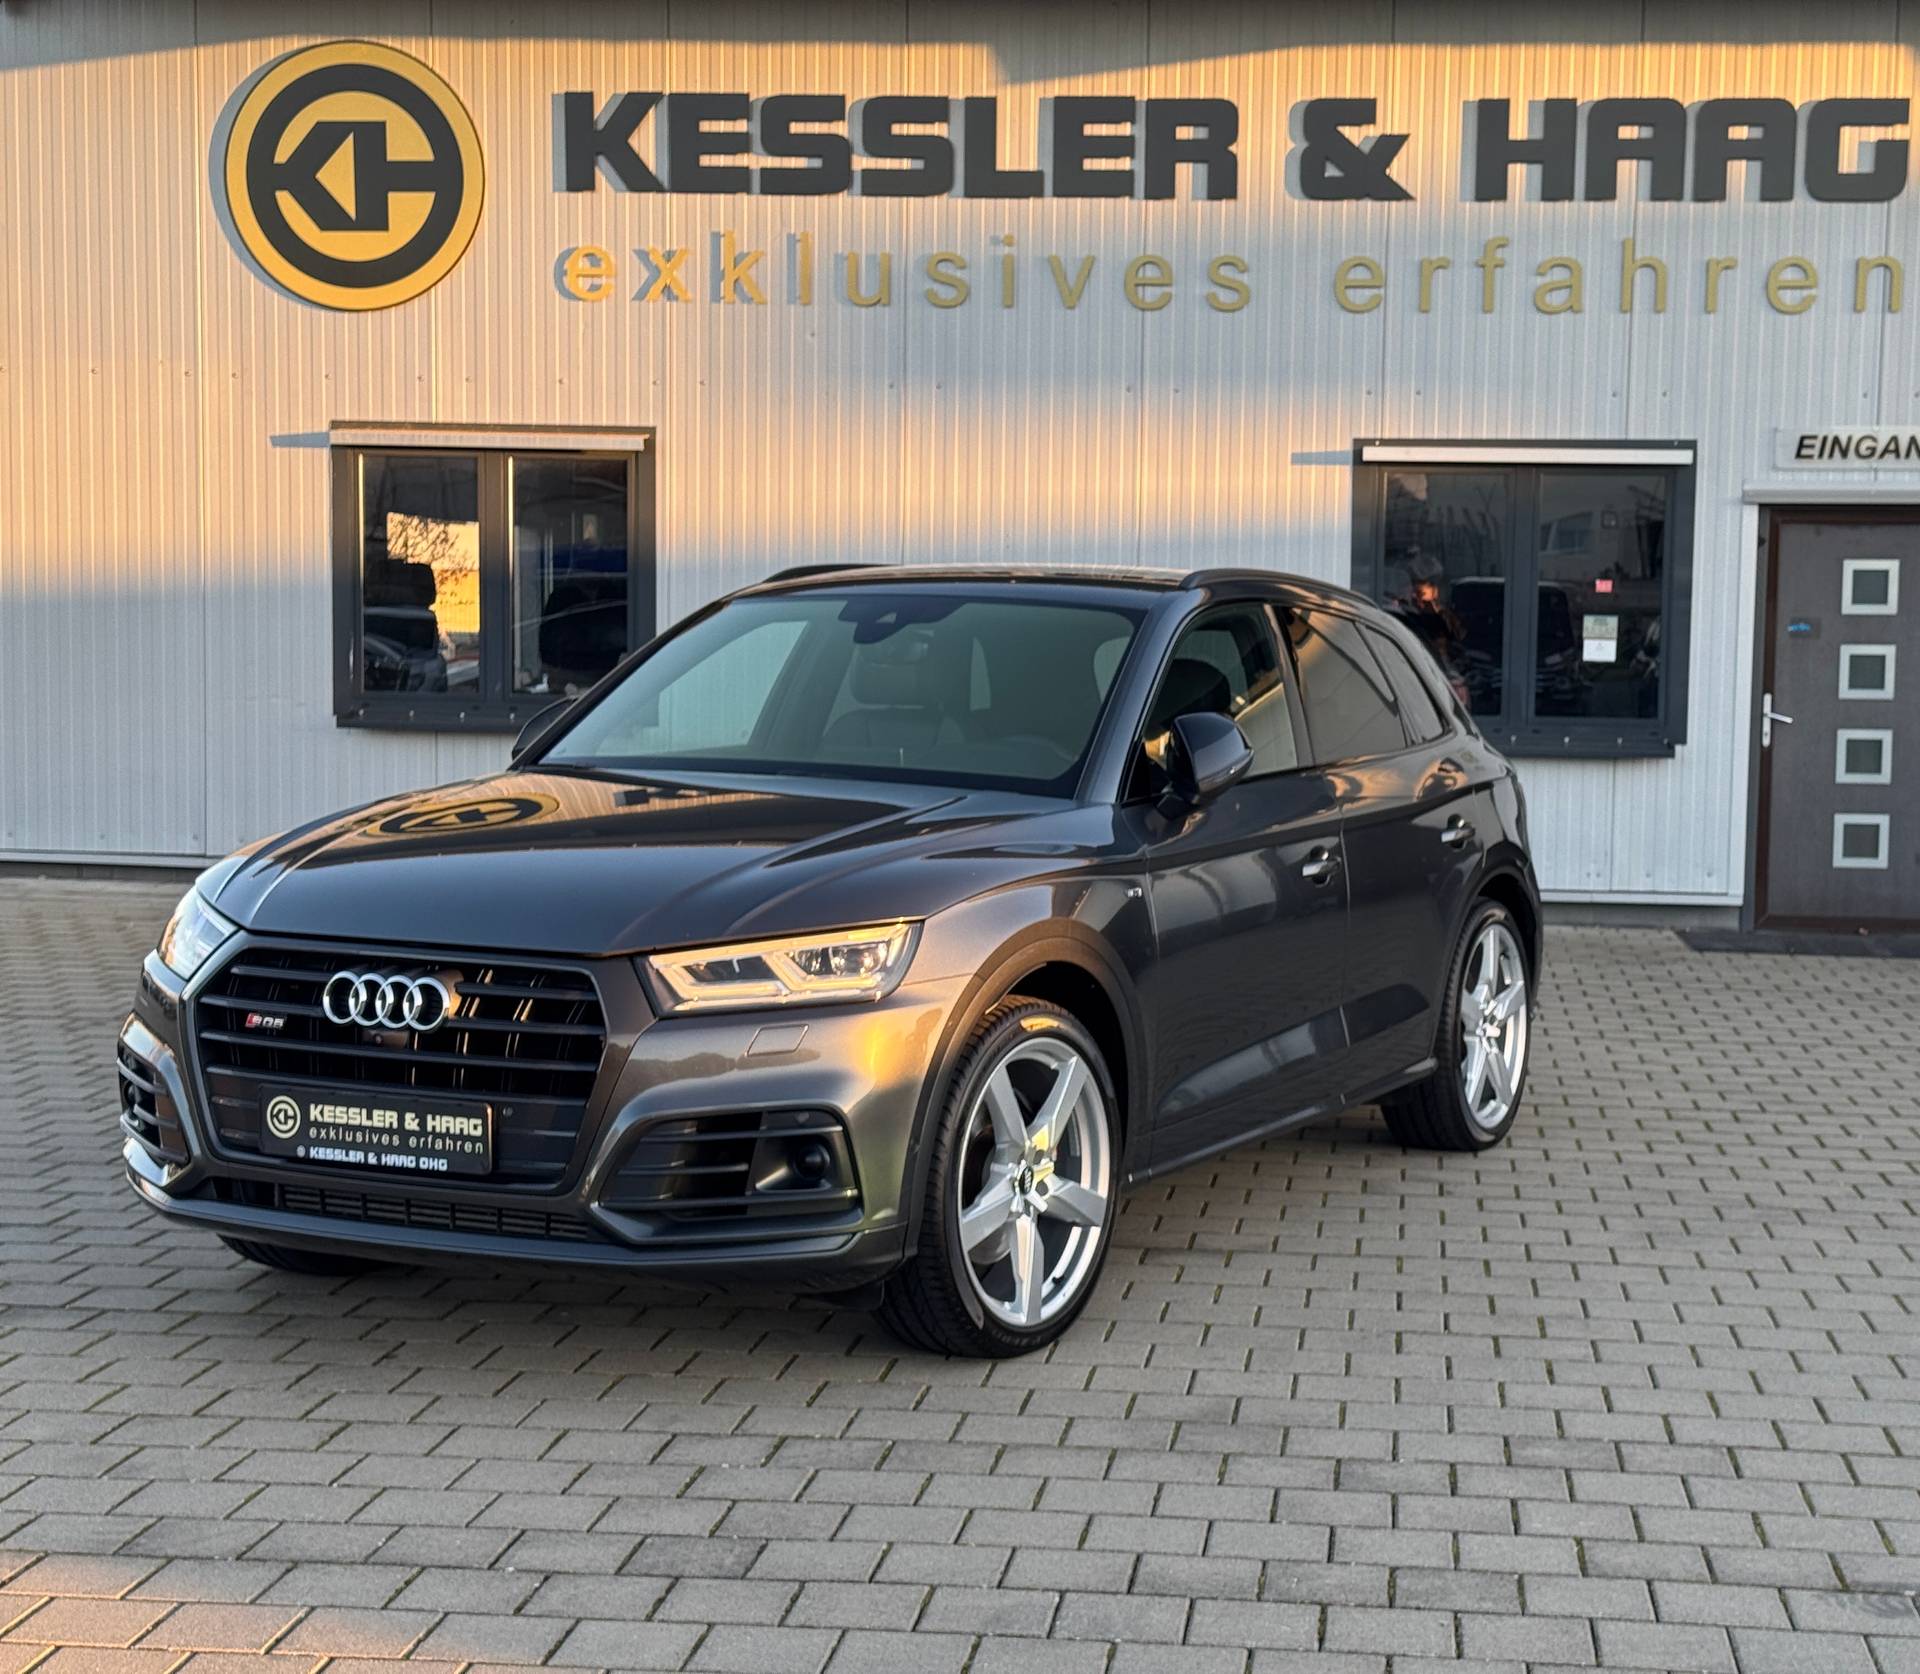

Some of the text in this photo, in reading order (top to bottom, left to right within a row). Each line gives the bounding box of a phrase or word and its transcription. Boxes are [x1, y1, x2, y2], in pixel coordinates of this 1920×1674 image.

[565, 91, 1910, 203] KESSLER & HAAG
[565, 230, 1904, 315] exklusives erfahren
[309, 1103, 483, 1137] KESSLER & HAAG
[309, 1125, 484, 1154] exklusives erfahren
[309, 1145, 448, 1171] KESSLER & HAAG OHG
